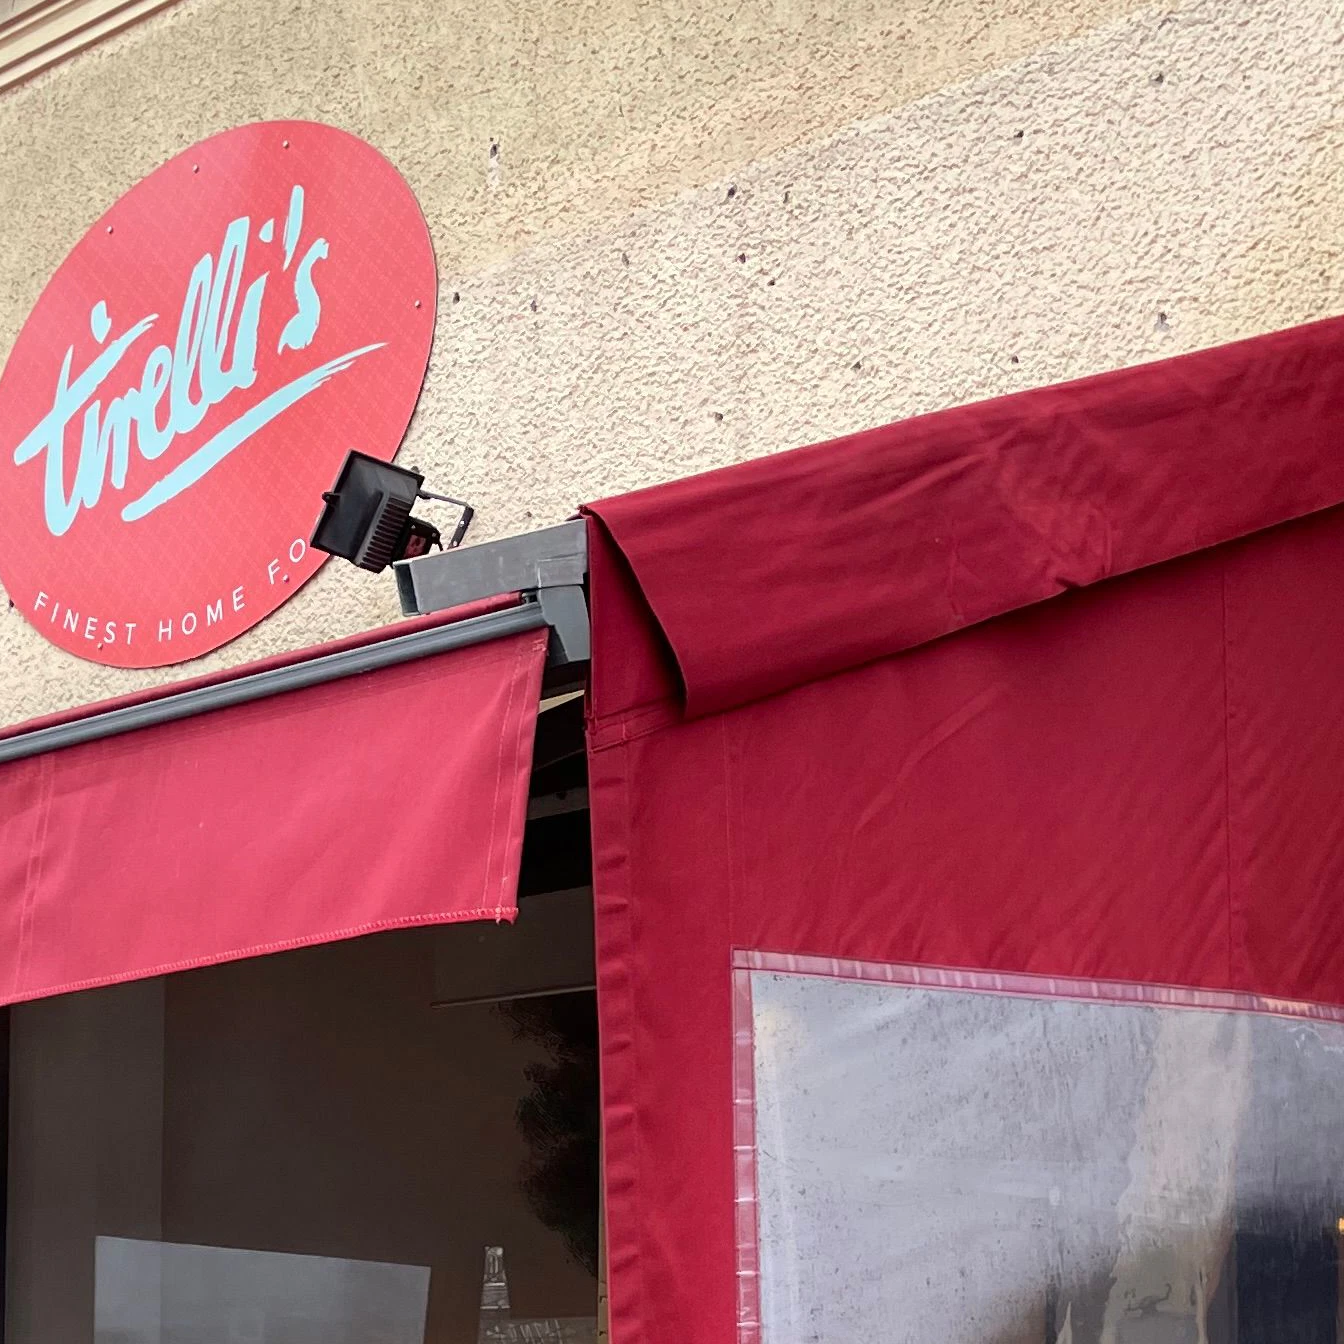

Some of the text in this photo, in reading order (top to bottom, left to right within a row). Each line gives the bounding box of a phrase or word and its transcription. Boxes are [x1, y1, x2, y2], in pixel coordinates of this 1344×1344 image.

[14, 184, 329, 536] tirelli's
[33, 590, 137, 645] FINEST
[157, 584, 246, 642] HOME
